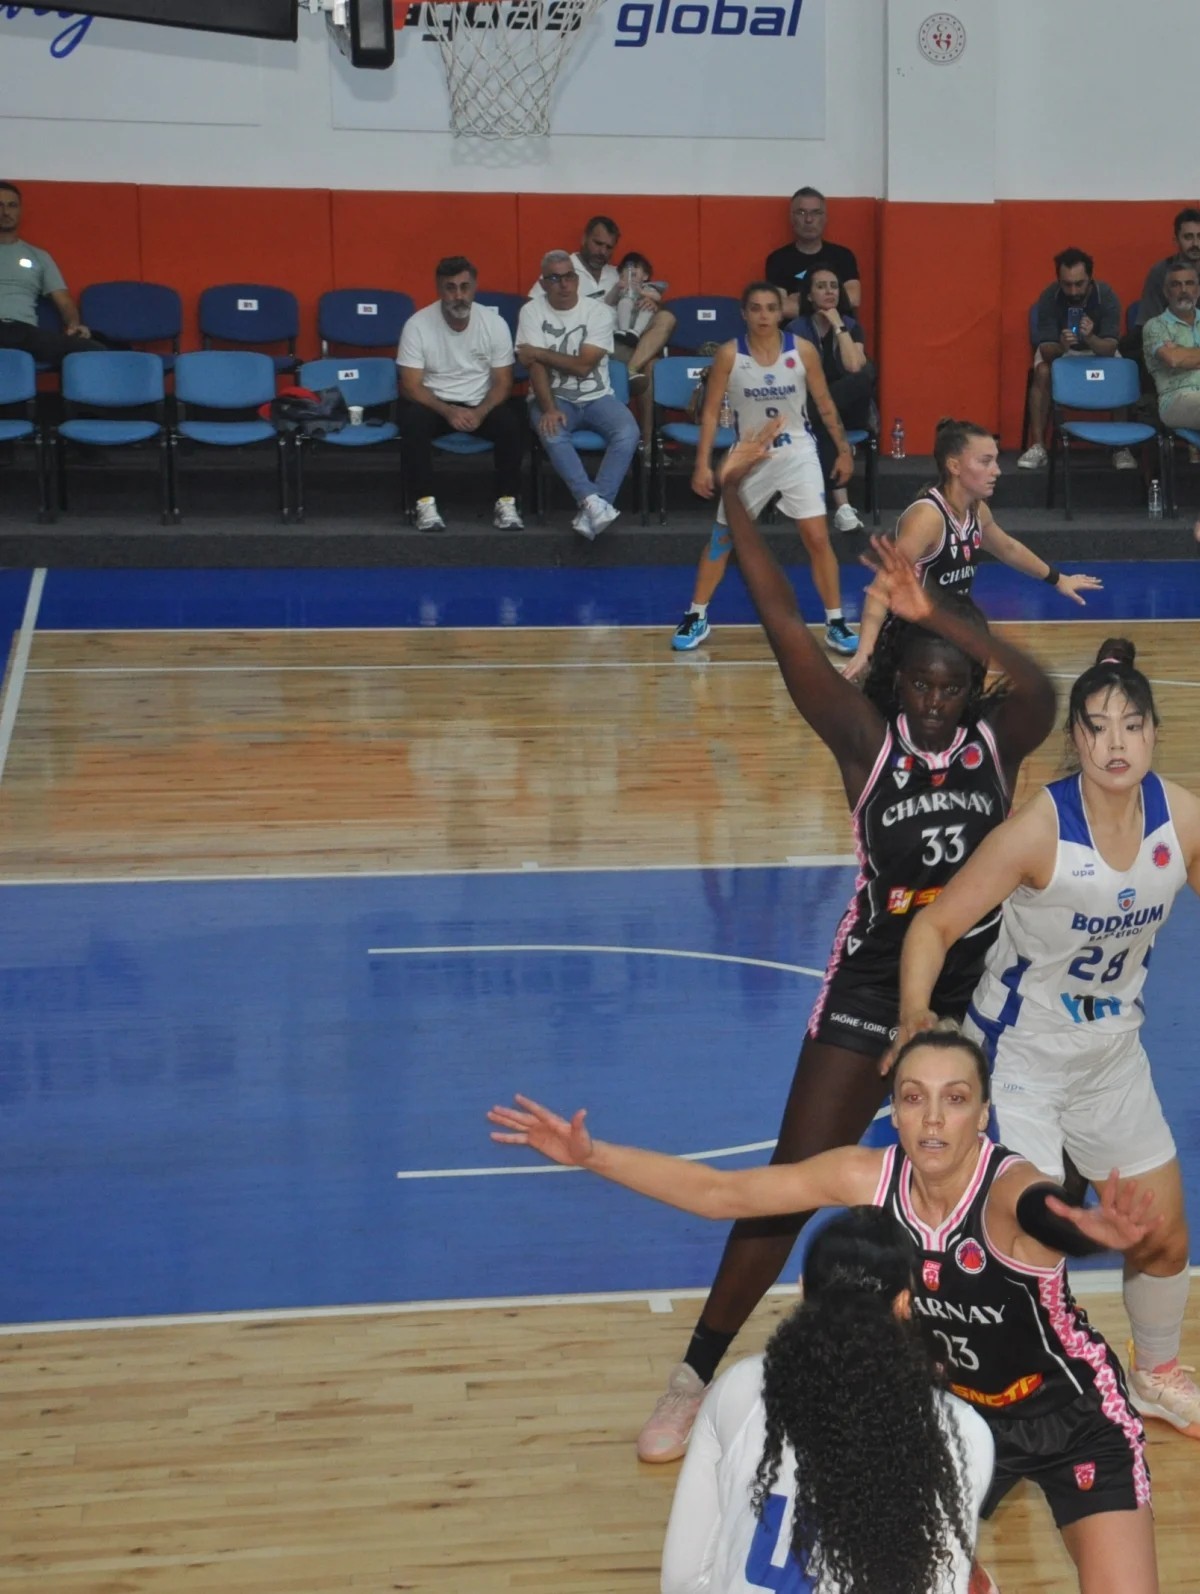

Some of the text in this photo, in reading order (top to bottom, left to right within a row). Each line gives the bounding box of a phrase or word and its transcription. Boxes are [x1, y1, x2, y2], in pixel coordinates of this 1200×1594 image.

[614, 0, 802, 47] global
[743, 384, 797, 398] BODRUM
[882, 791, 994, 827] CHARNAY
[921, 822, 966, 867] 33
[1071, 904, 1164, 935] BODRUM
[1067, 945, 1130, 984] 28
[914, 1296, 1006, 1325] ARNAY
